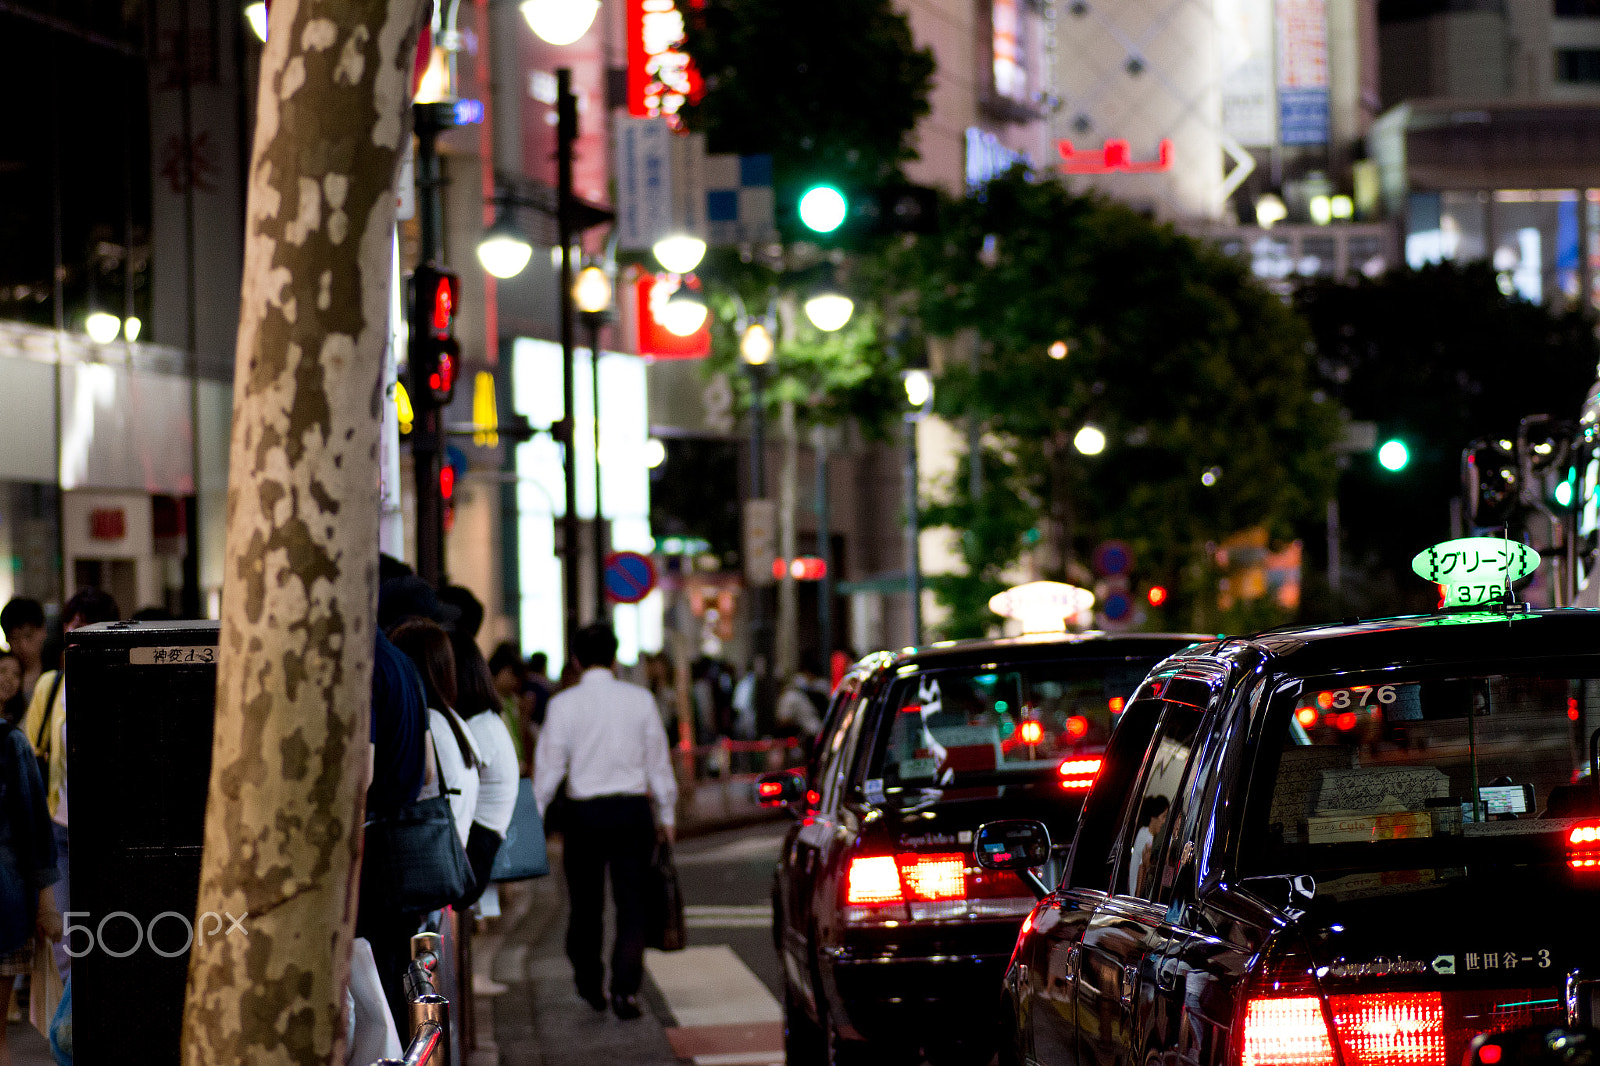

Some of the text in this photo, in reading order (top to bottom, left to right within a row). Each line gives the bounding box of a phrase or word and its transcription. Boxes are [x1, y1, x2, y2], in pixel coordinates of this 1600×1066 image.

[1440, 550, 1515, 575] グリーン
[1457, 584, 1502, 603] 376
[1331, 684, 1398, 709] 376
[1464, 948, 1552, 971] 世田谷-3
